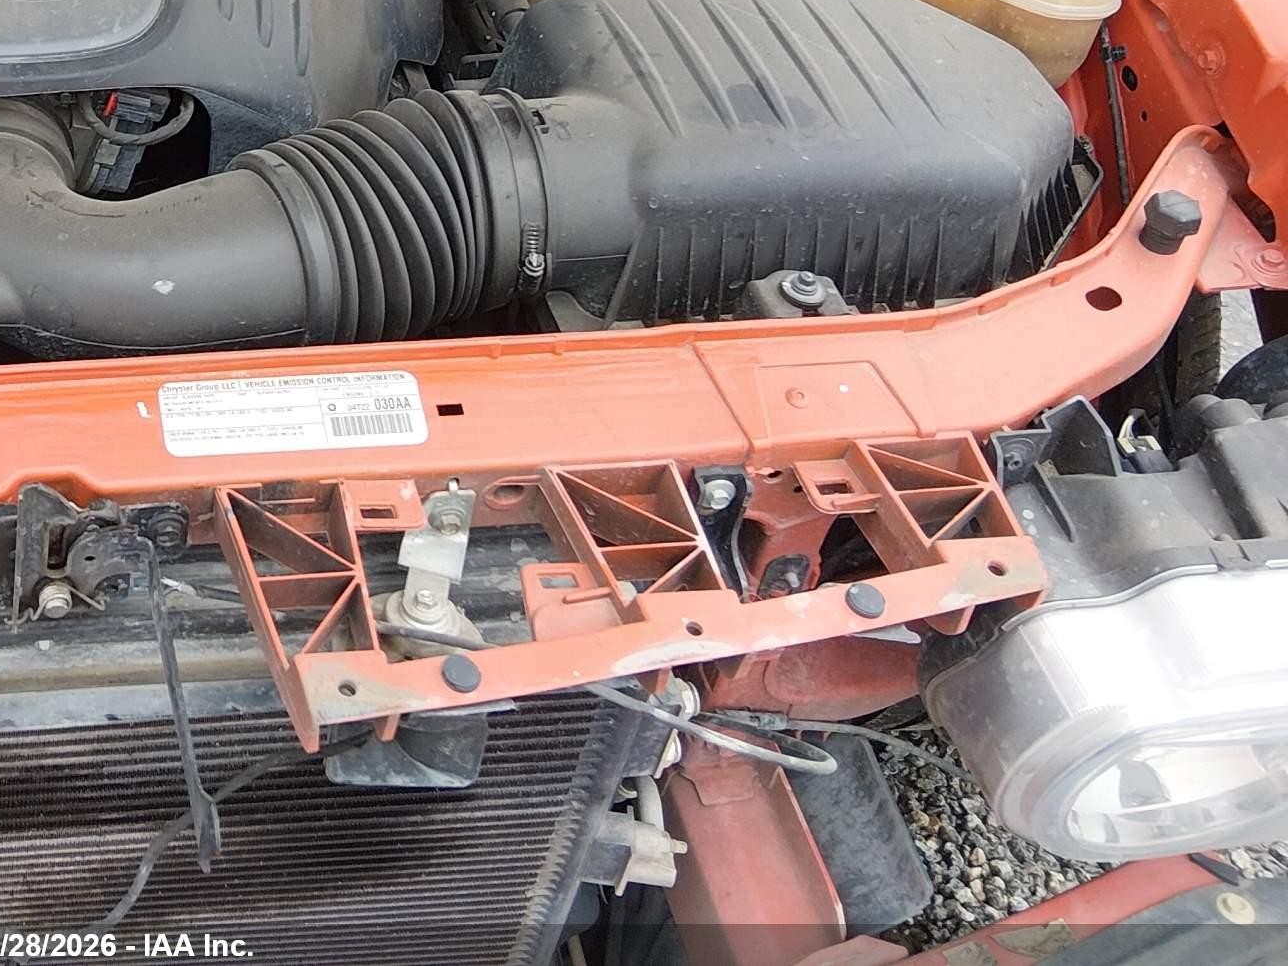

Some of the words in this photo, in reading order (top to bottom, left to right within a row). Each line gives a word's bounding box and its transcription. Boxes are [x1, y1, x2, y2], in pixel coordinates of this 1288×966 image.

[161, 384, 194, 394] Chrysler
[195, 382, 219, 392] Group
[221, 381, 236, 390] LLC
[244, 379, 276, 389] VEHICLE
[278, 377, 315, 387] EMISSION
[316, 376, 352, 385] CONTROL
[353, 373, 406, 383] INFORMATION
[374, 397, 412, 410] 030AA
